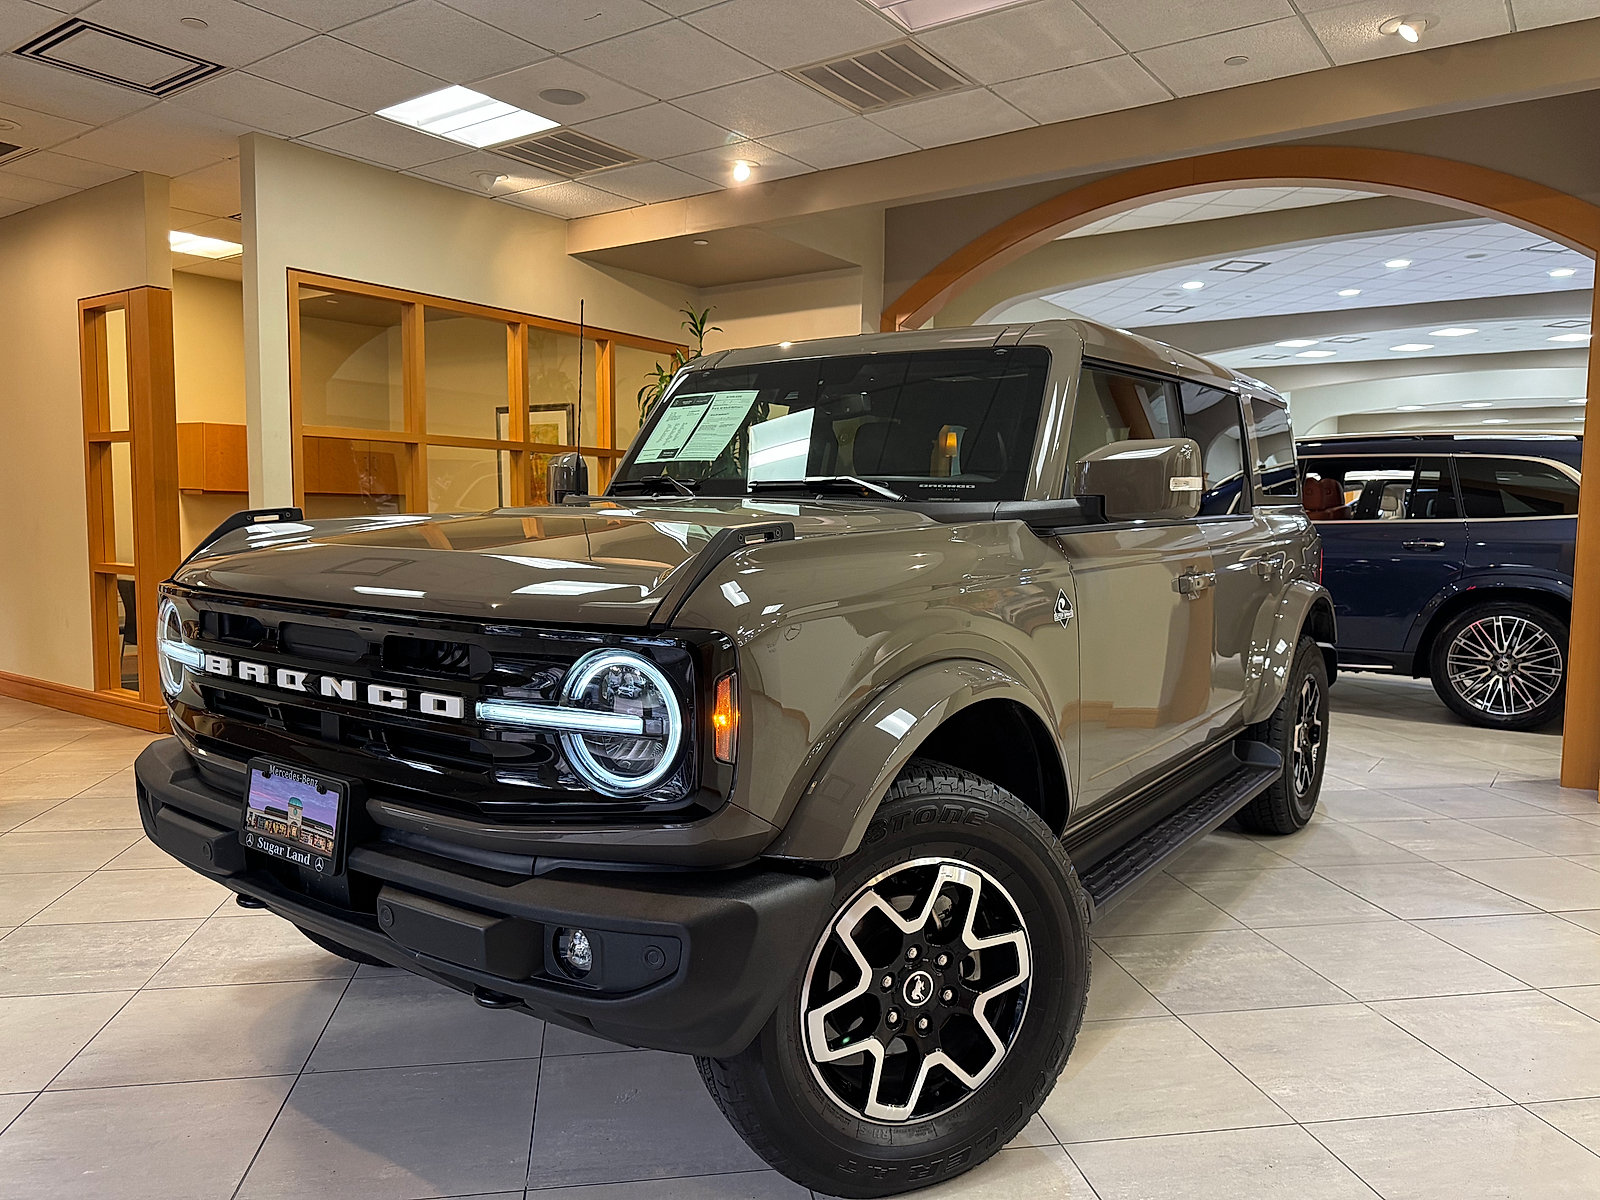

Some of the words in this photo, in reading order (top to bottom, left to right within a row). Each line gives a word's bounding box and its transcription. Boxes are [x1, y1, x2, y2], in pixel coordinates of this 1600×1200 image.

[205, 654, 464, 719] BRONCO
[269, 764, 318, 787] Mercedes-Benz
[257, 836, 285, 856] Sugar
[286, 846, 311, 866] Land
